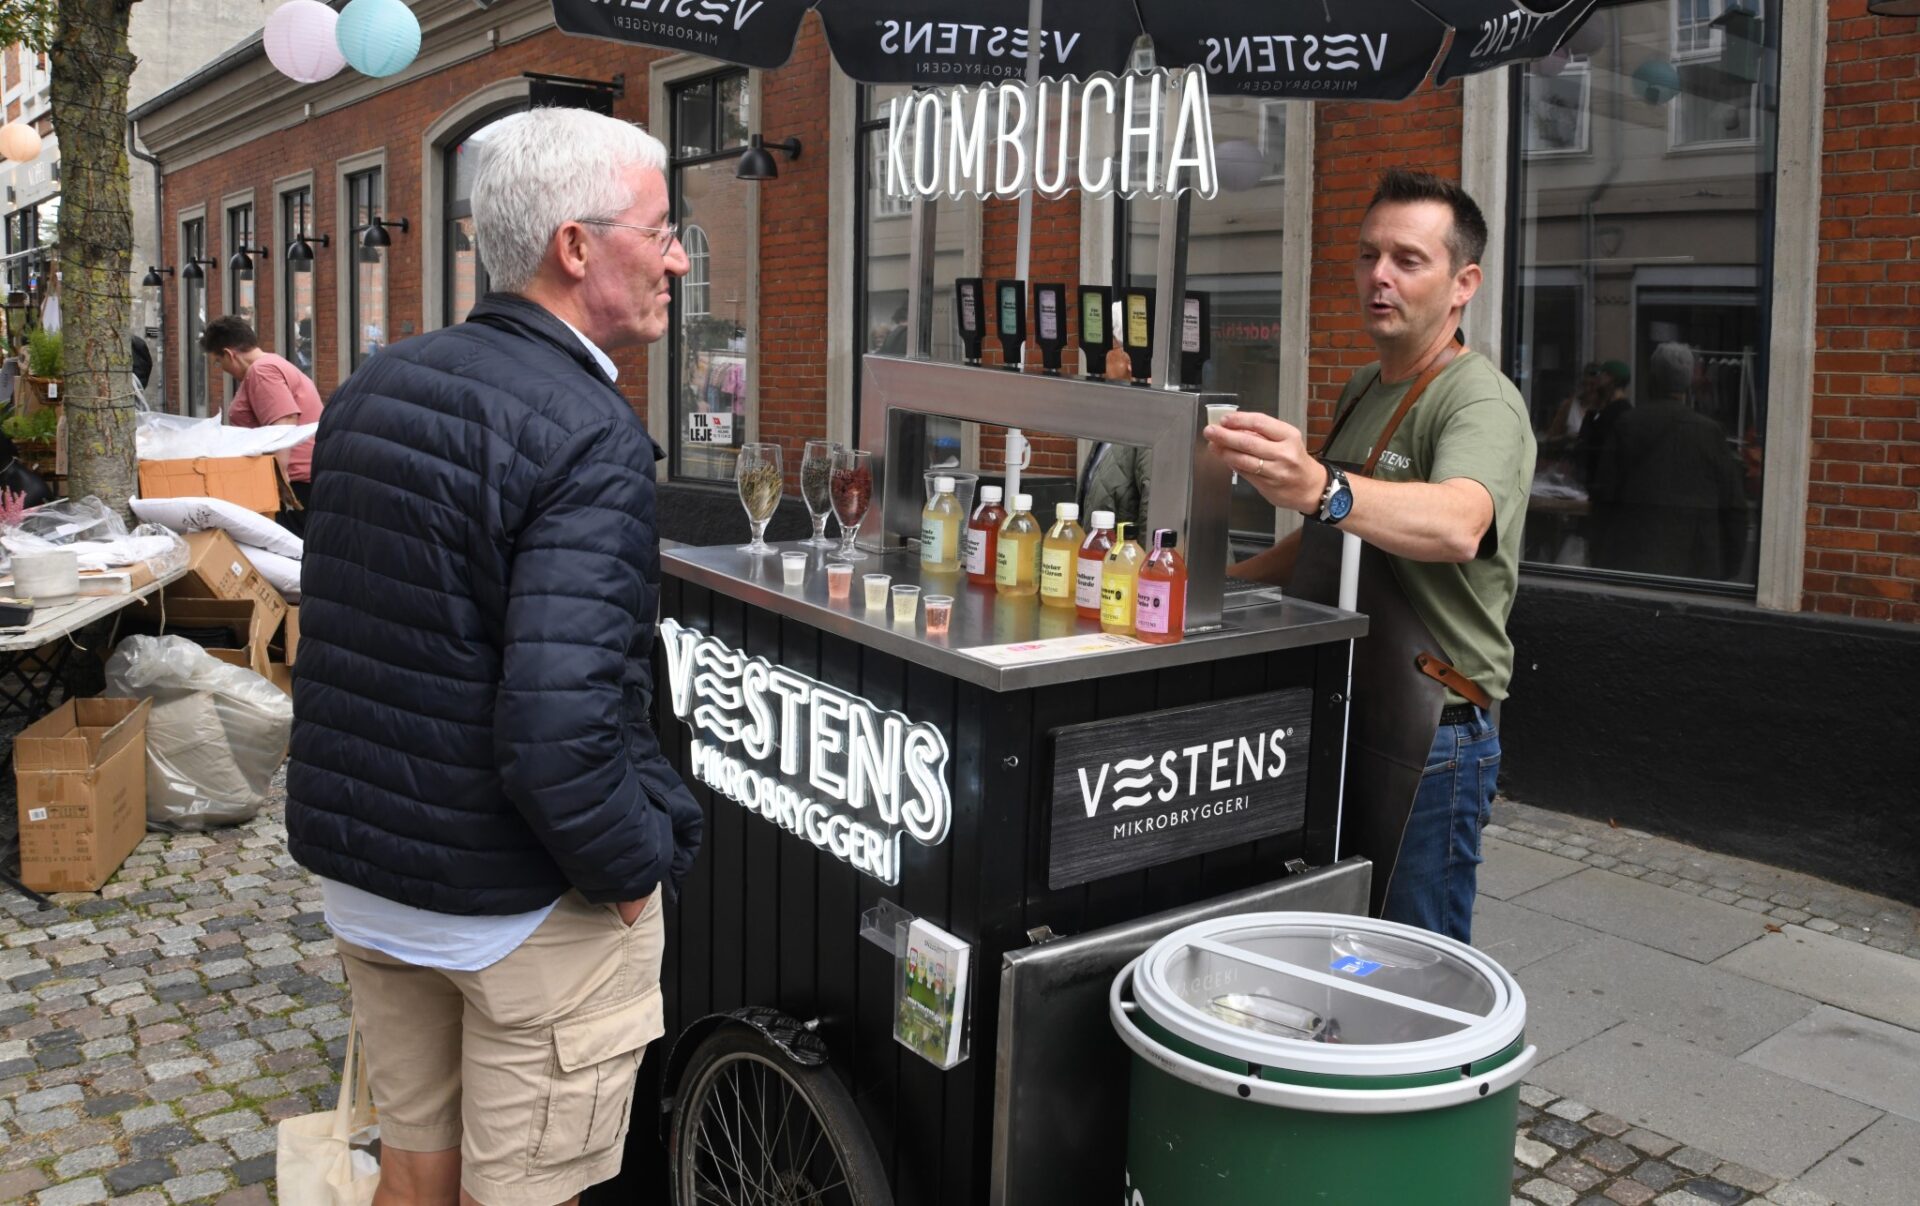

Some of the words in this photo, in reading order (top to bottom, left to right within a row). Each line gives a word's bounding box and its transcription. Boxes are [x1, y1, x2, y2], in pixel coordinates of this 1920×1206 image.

[887, 71, 1213, 196] KOMBUCHA
[690, 428, 713, 442] LEJE
[694, 414, 708, 427] TIL
[690, 739, 894, 882] MIKROBRYGGERI
[1112, 795, 1250, 840] MIKROBRYGGERI
